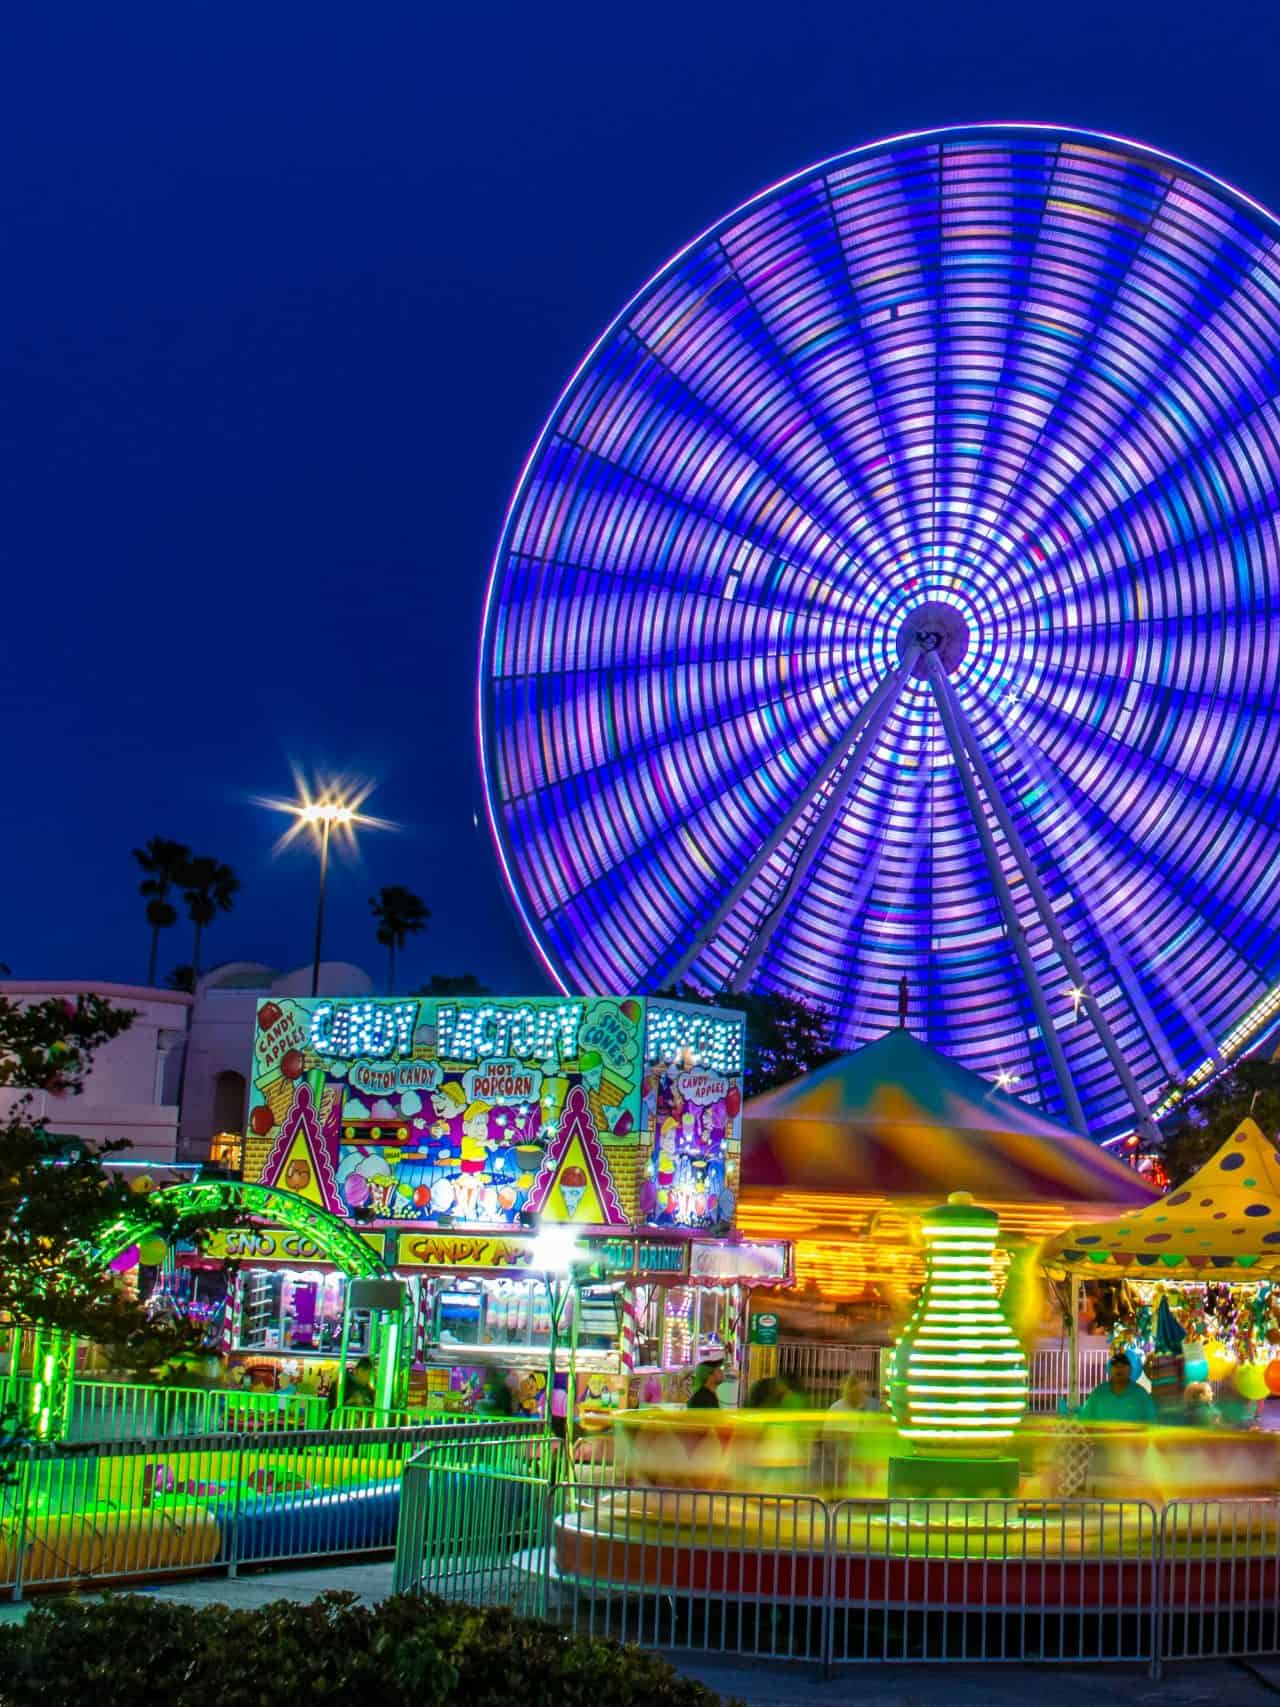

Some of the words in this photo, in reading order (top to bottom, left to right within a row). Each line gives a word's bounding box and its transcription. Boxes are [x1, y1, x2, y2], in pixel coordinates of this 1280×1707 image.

[259, 1012, 295, 1053] CANDY
[311, 1001, 418, 1060] CANDY
[436, 1003, 584, 1062] FACTORY
[600, 1015, 628, 1045] SNO
[646, 1009, 742, 1072] POPCORN
[264, 1027, 306, 1067] APPLES
[585, 1027, 625, 1066] CONES
[357, 1067, 396, 1088] COTTON
[399, 1066, 436, 1086] CANDY
[487, 1064, 513, 1076] HOT
[682, 1076, 709, 1088] CANDY
[474, 1077, 533, 1097] POPCORN
[695, 1083, 725, 1097] APPLES
[225, 1233, 276, 1256] SNO
[410, 1237, 489, 1264] CANDY
